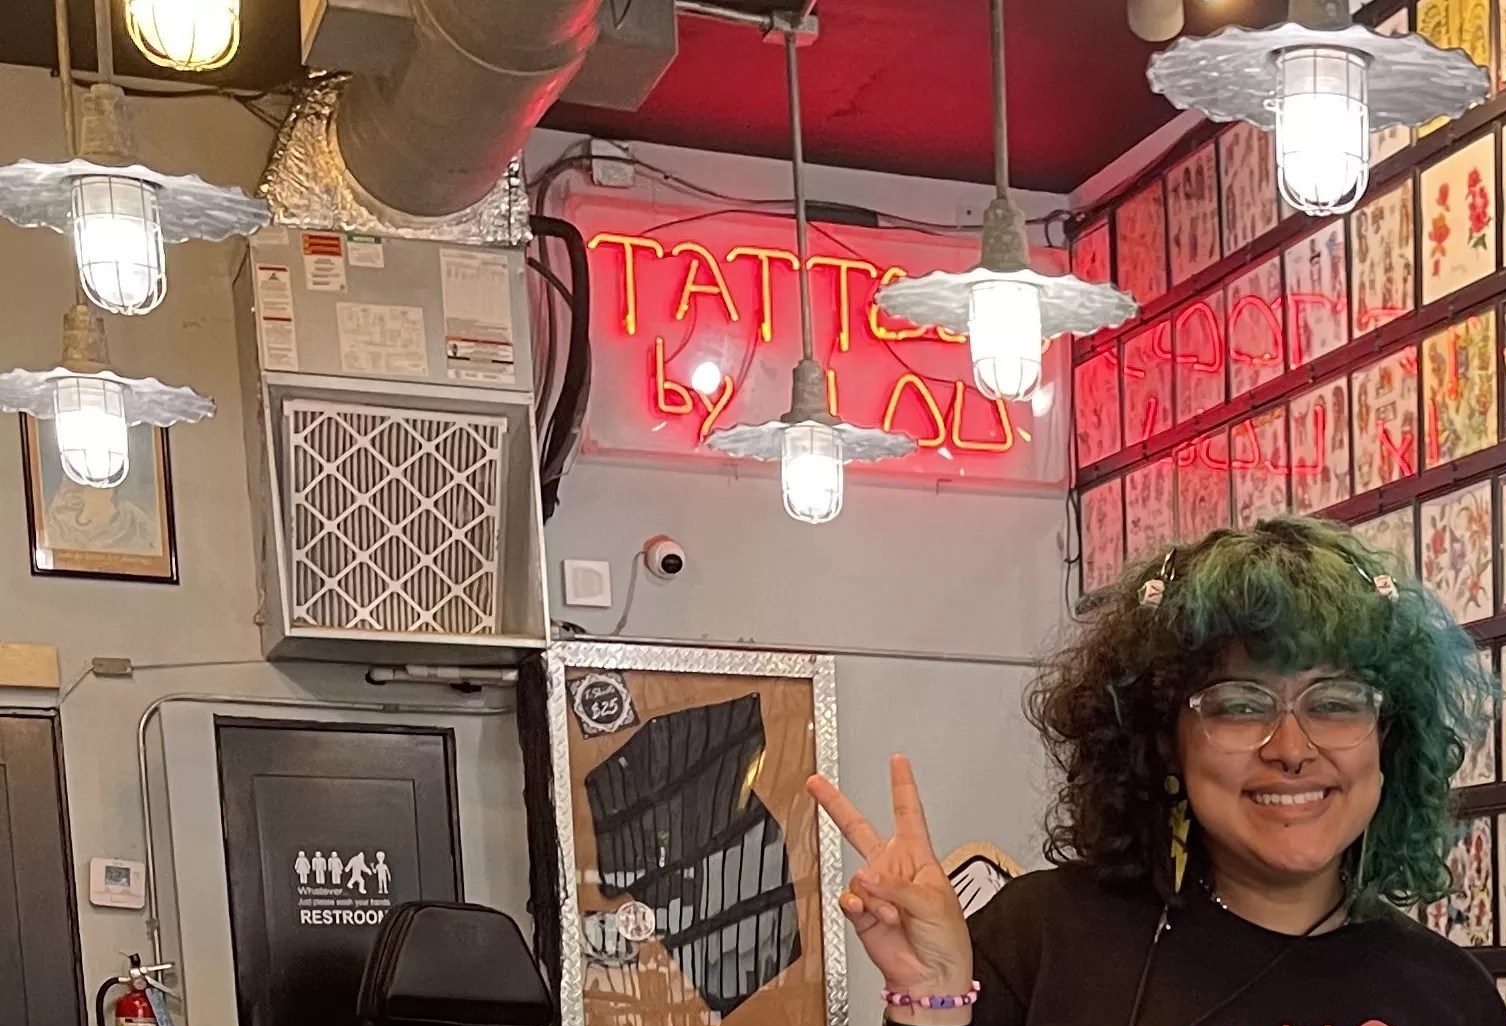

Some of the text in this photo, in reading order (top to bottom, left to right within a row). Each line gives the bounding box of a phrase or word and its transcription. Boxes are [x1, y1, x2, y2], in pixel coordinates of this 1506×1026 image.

[587, 232, 1050, 353] TATTO
[656, 337, 734, 445] by
[591, 697, 618, 720] $25
